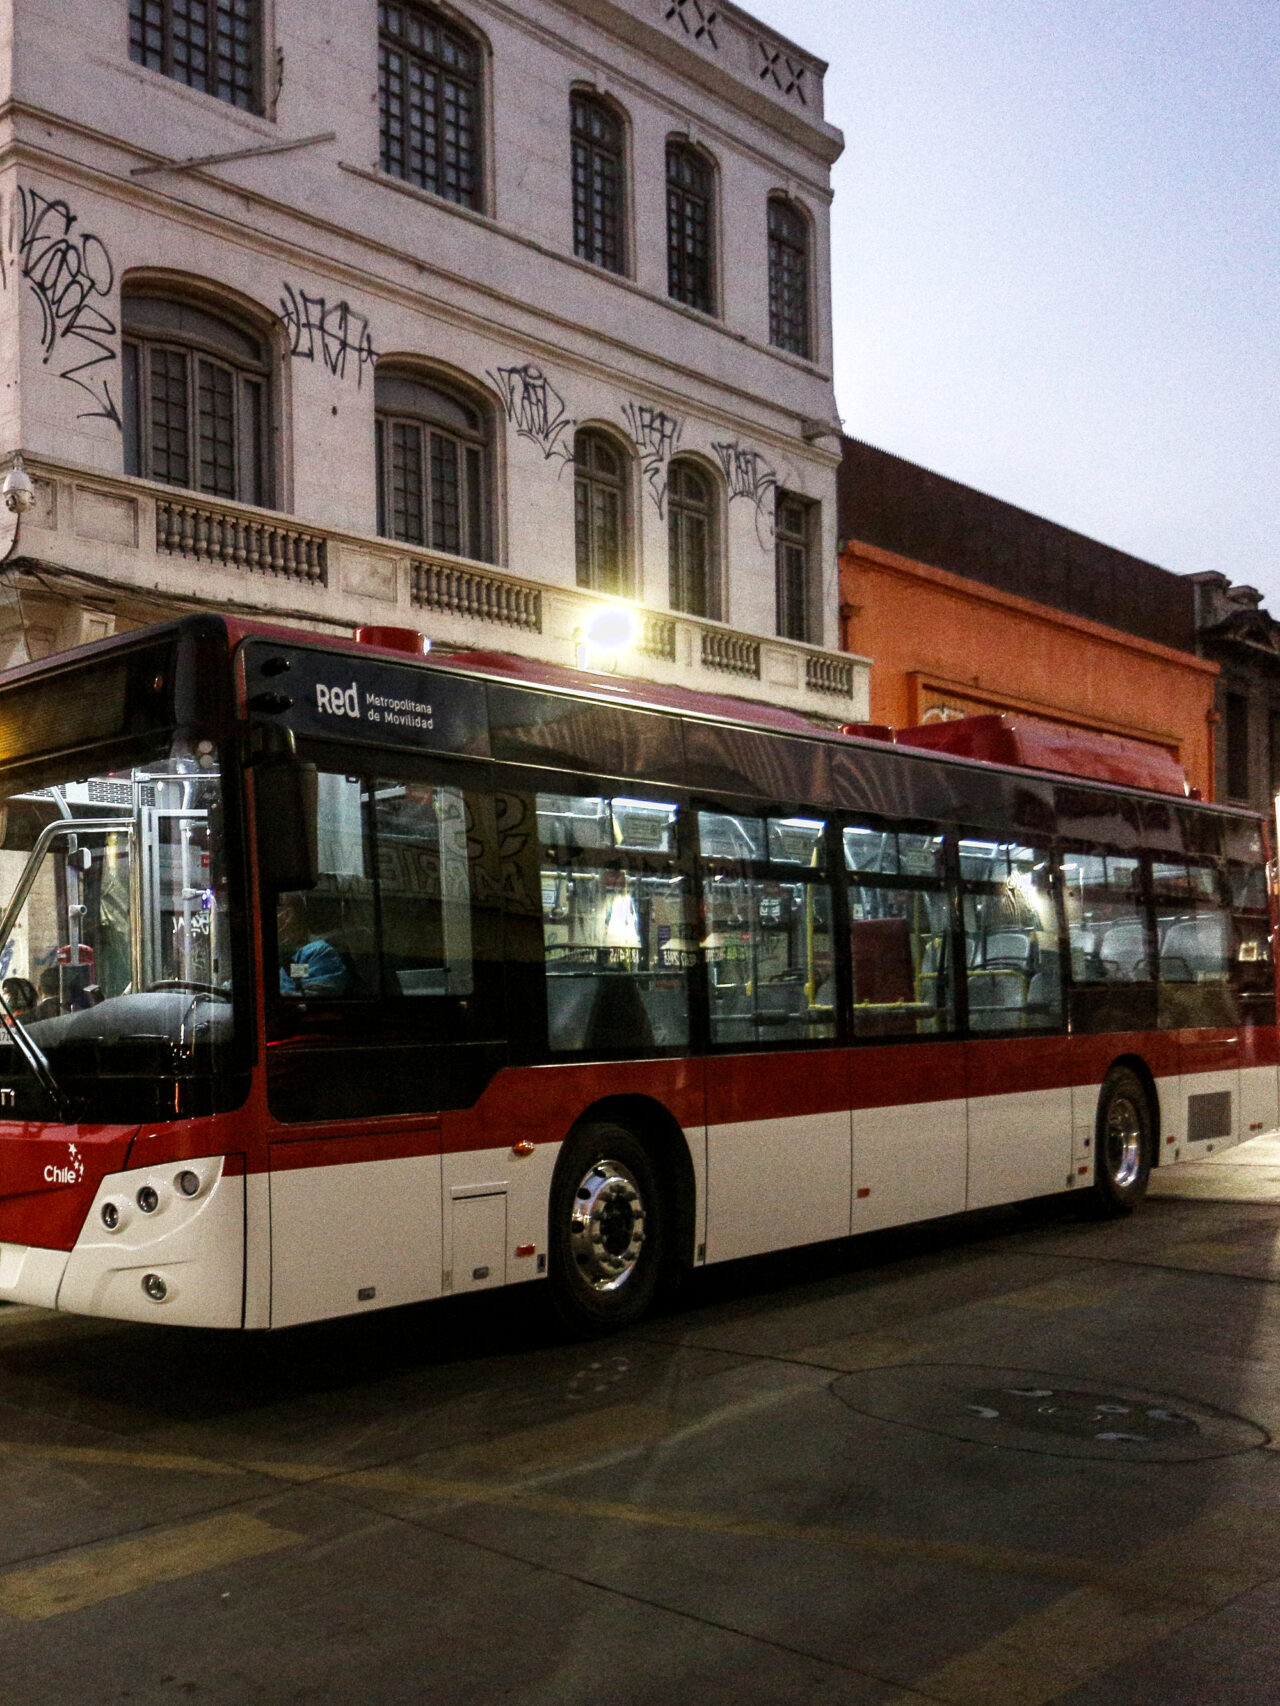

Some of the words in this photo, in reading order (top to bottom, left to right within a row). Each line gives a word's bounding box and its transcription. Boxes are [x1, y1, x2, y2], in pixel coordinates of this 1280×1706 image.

[316, 681, 360, 718] Red
[365, 693, 433, 714] Metropolitana
[368, 709, 381, 722] de
[384, 711, 434, 730] Movilidad
[43, 1164, 76, 1184] Chile
